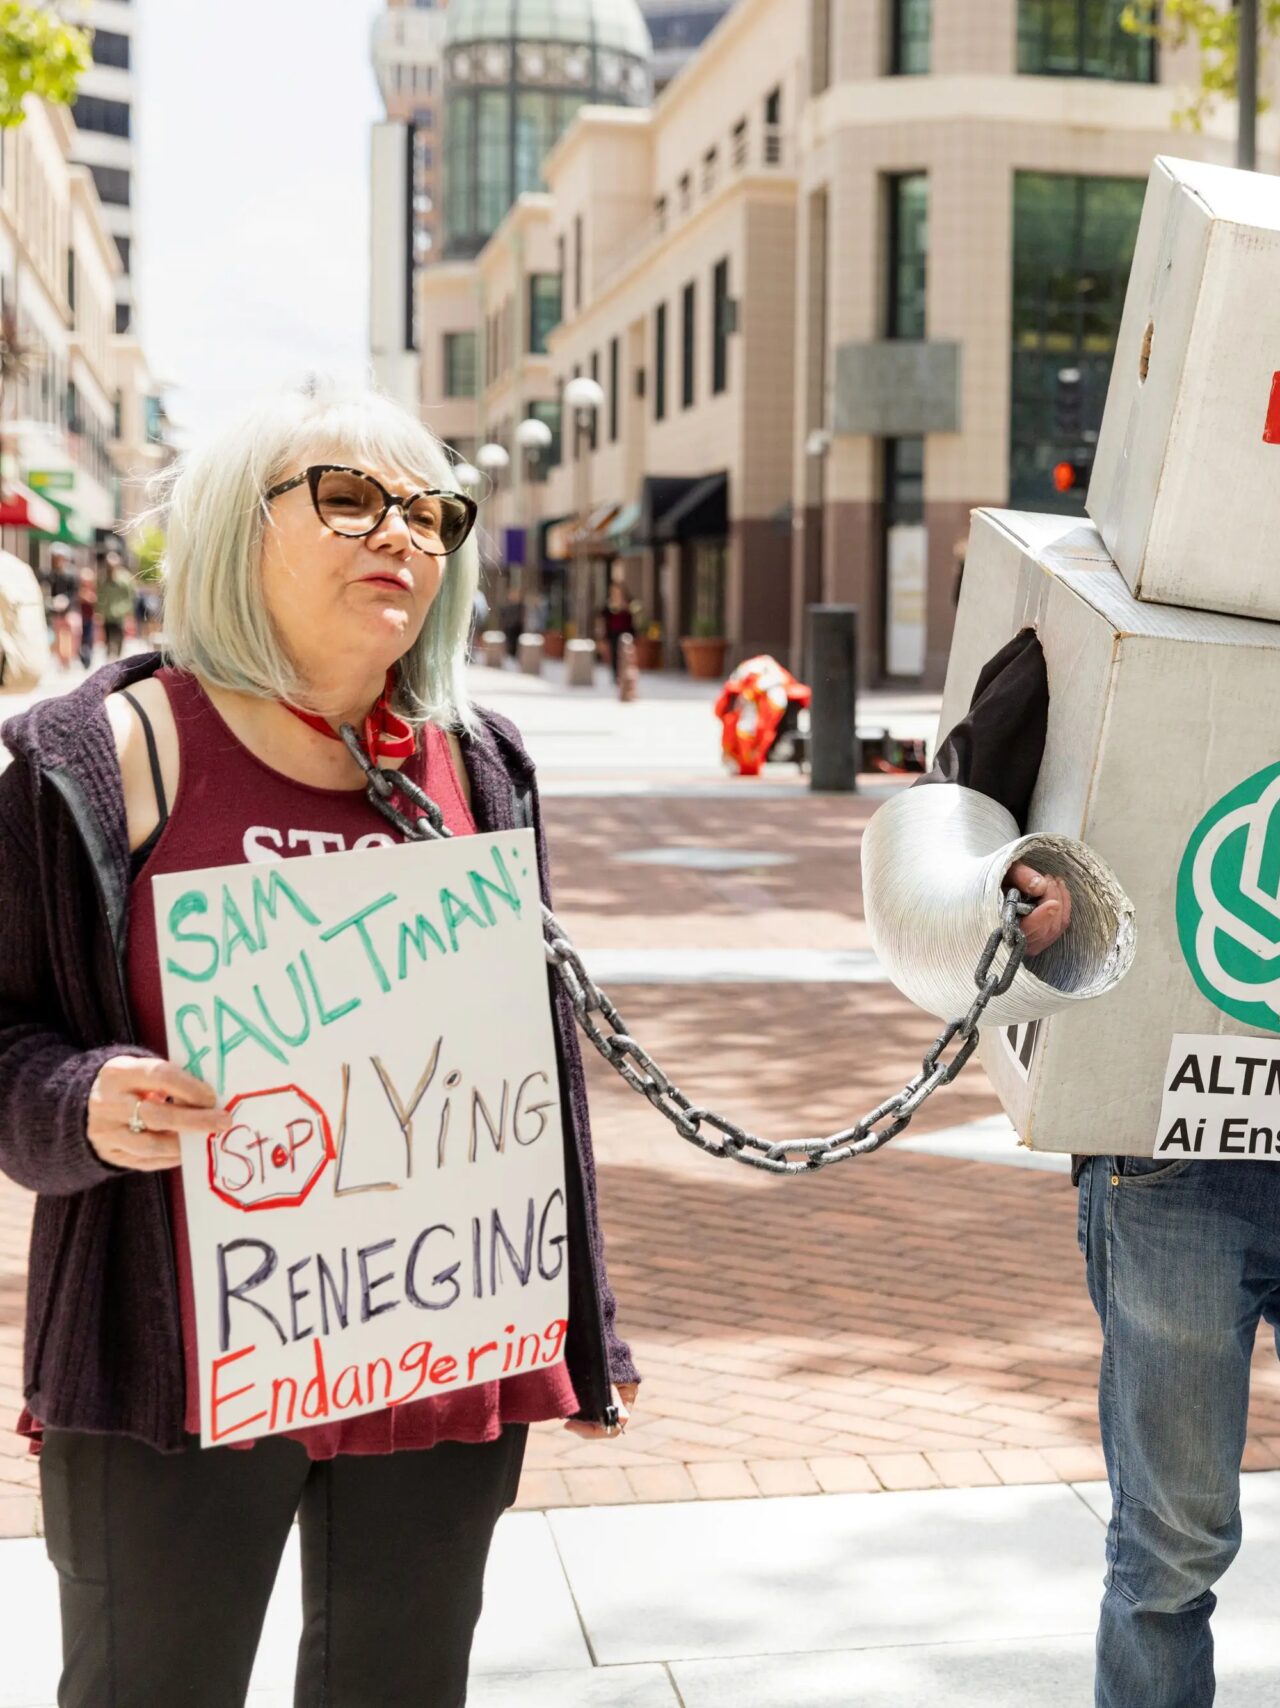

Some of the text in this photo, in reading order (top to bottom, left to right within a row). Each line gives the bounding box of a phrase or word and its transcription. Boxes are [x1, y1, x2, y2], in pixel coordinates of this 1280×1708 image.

[167, 869, 322, 983] SAM
[1159, 1117, 1205, 1153] Ai
[216, 1187, 568, 1352] RENEGING
[211, 1317, 568, 1442] Endangering
